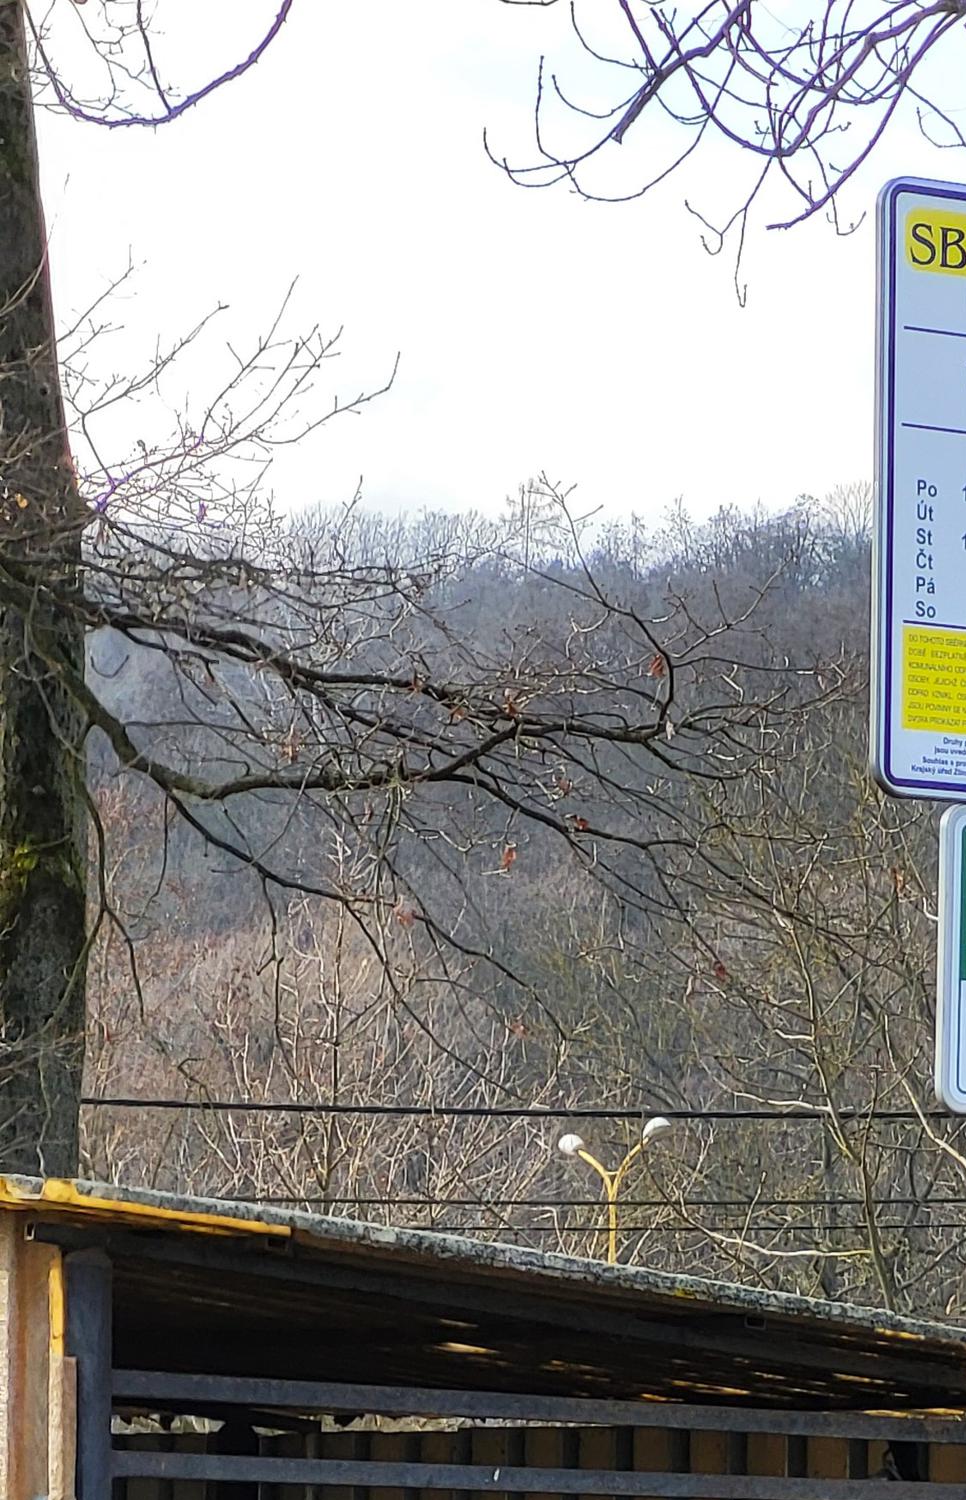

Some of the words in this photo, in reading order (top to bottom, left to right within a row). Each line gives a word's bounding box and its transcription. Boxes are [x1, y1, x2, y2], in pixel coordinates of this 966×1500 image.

[917, 480, 937, 496] Po
[917, 503, 934, 521] Út
[916, 528, 933, 545] St
[916, 550, 933, 570] Čt
[916, 577, 935, 594] Pá
[915, 601, 936, 618] So
